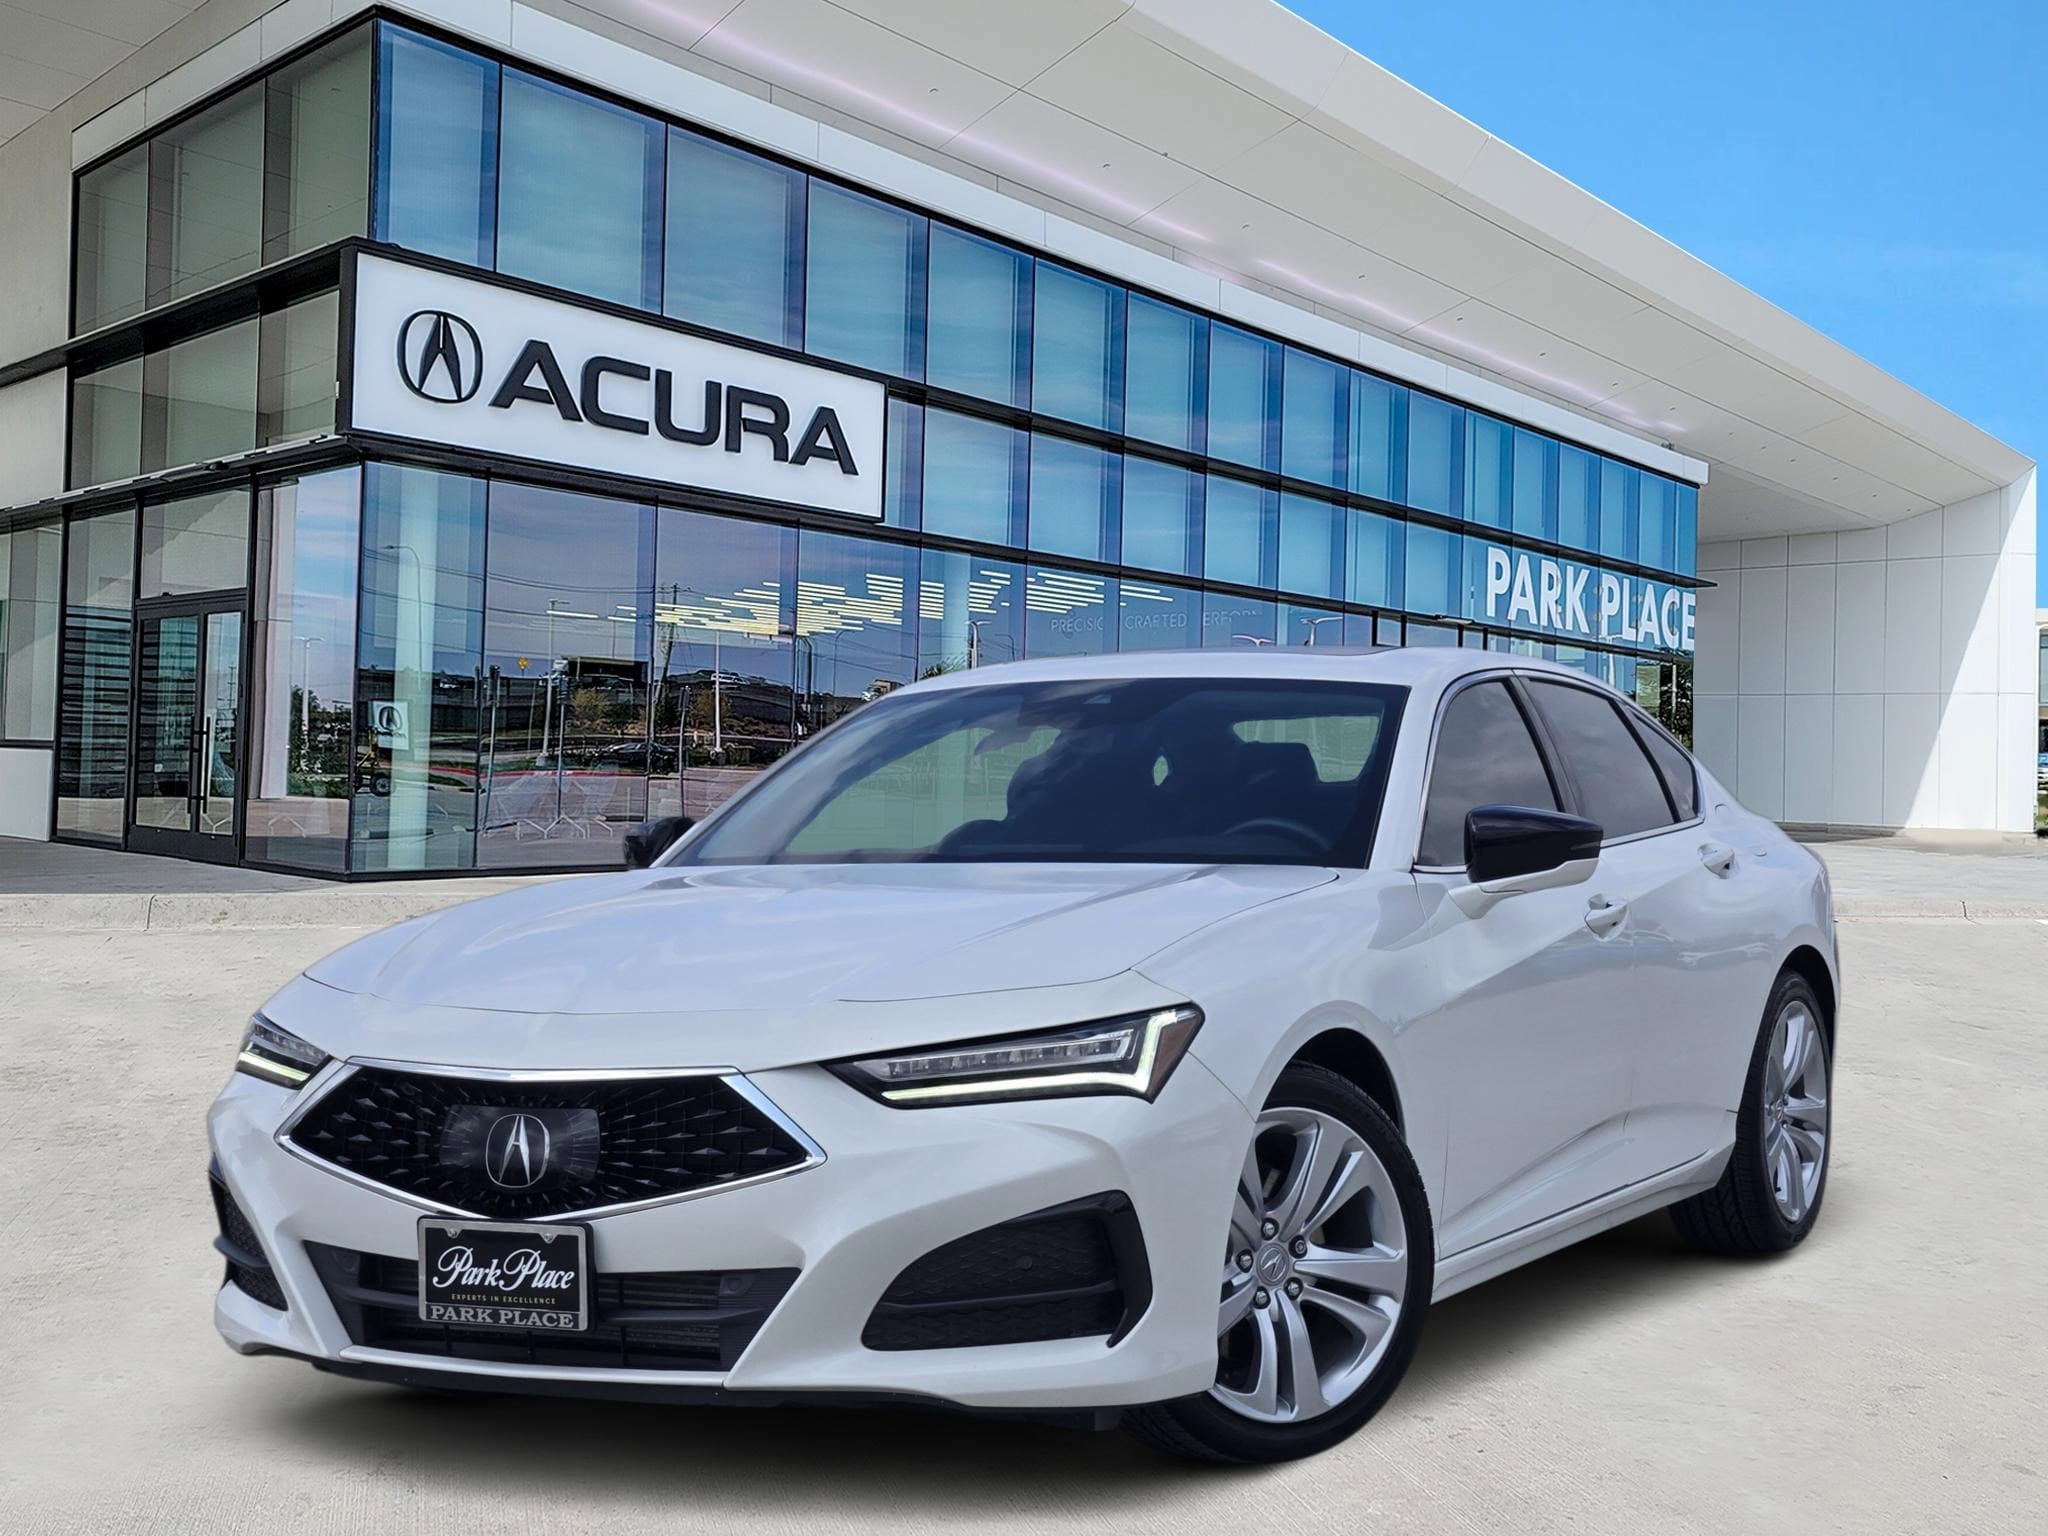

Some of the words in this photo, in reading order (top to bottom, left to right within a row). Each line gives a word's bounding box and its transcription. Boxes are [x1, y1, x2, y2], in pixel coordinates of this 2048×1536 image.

[488, 339, 859, 476] ACURA
[1487, 547, 1590, 633] PARK
[1601, 573, 1696, 650] PLACE
[1124, 613, 1188, 630] CRAFTED
[432, 1246, 501, 1288] Park
[499, 1248, 575, 1291] Place
[451, 1293, 487, 1302] EXPERTS
[490, 1295, 500, 1303] IN
[502, 1296, 556, 1305] EXCELLENCE
[431, 1305, 494, 1323] PARK
[499, 1310, 574, 1328] PLACE
